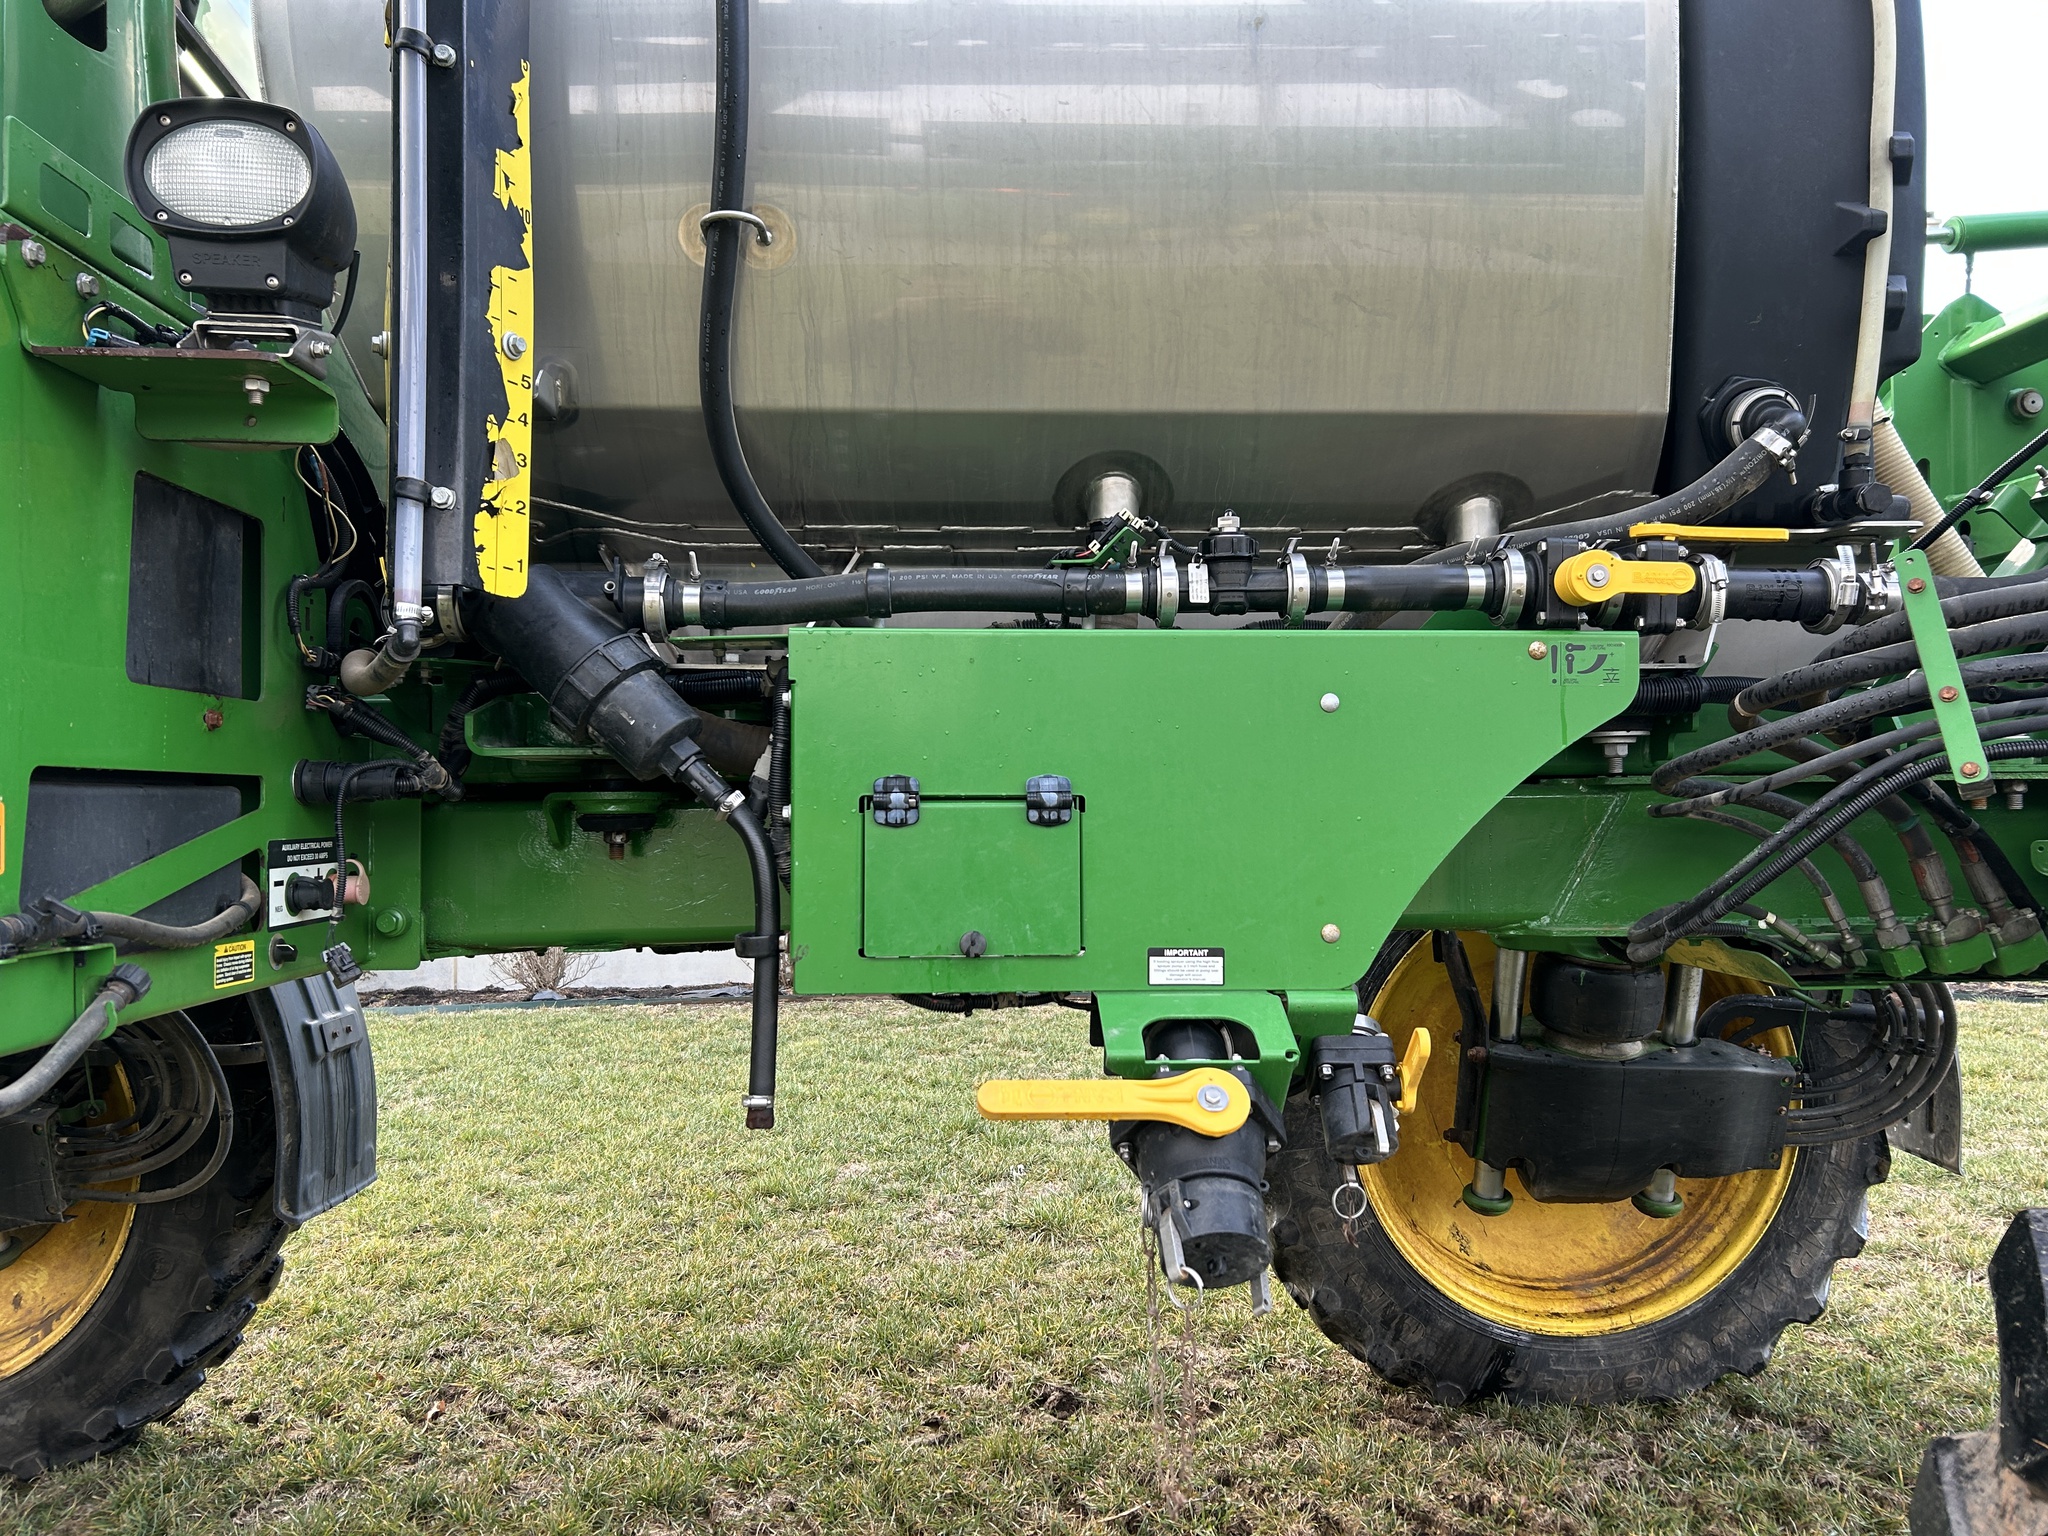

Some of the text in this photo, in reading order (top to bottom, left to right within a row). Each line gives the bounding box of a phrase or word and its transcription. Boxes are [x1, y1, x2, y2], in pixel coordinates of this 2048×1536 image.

[192, 253, 261, 267] SPEAKER
[520, 374, 531, 390] 5
[517, 412, 529, 427] 4
[516, 453, 528, 468] 3
[1739, 450, 1768, 477] ORIZON™
[515, 500, 526, 515] 2
[1683, 500, 1696, 511] 200
[1669, 508, 1682, 518] PSI
[1596, 529, 1613, 537] USA
[516, 559, 523, 573] 1
[1011, 572, 1059, 581] GOODYEAR
[754, 587, 798, 596] GOODYEAR
[300, 842, 320, 850] ELECTRICAL
[293, 854, 301, 862] NOT
[301, 853, 315, 861] EXCEED
[275, 905, 283, 913] NEG
[229, 944, 247, 953] CAUTION
[1164, 949, 1209, 957] IMPORTANT
